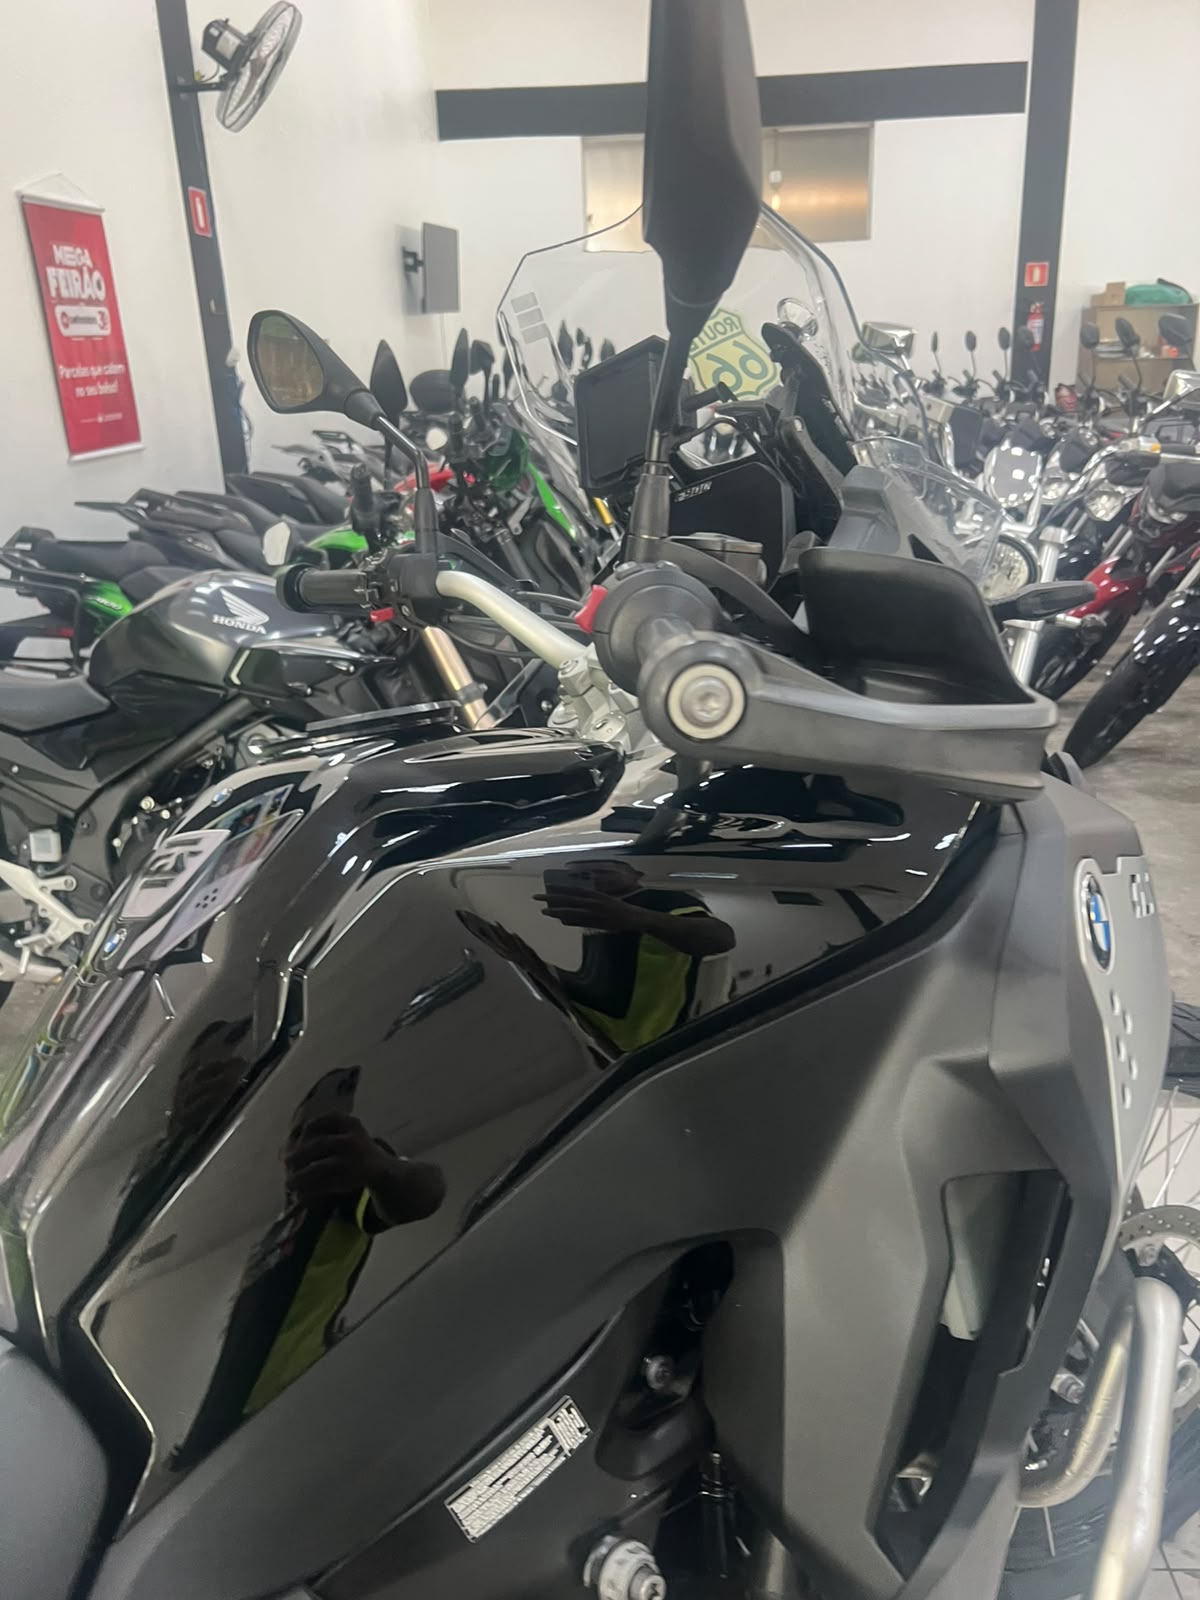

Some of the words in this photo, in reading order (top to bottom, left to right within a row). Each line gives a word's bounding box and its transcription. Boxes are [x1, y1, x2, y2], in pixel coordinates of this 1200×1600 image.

[52, 244, 93, 268] MEGA
[46, 266, 106, 300] FEIRÃO
[212, 614, 266, 634] HONDA
